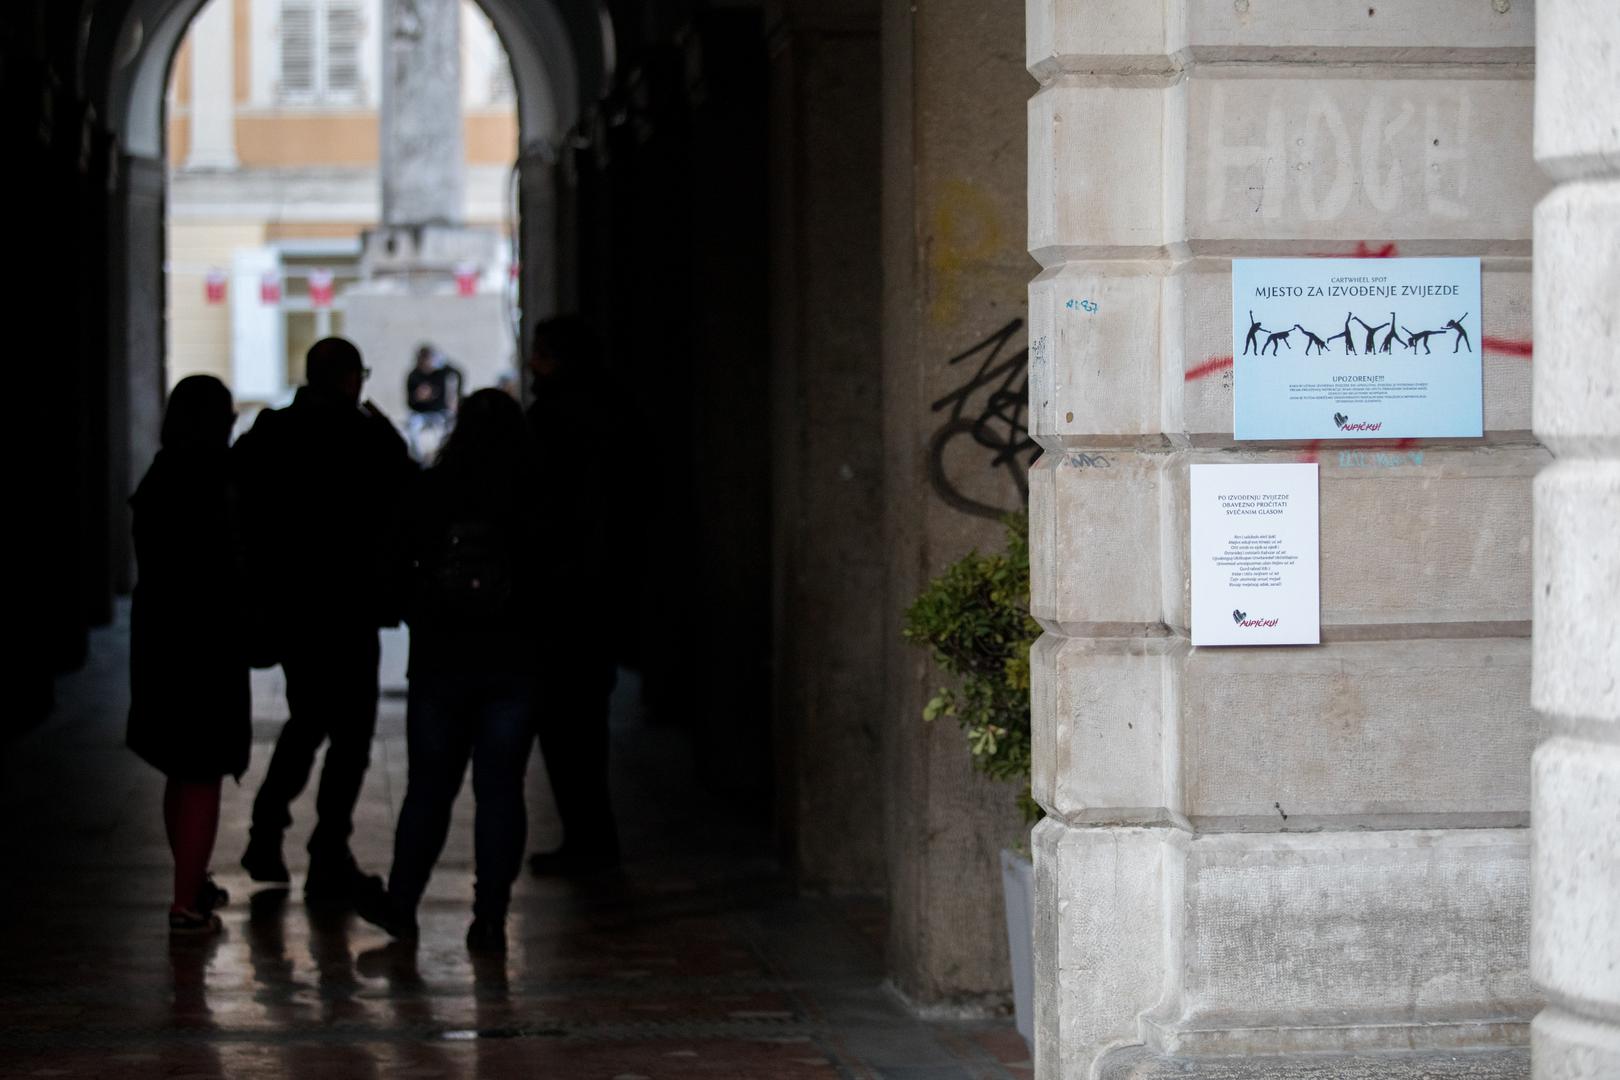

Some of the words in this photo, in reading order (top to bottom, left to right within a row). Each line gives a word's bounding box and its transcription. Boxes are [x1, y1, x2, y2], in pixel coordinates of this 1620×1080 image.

[1255, 286, 1303, 299] MJESTO
[1307, 286, 1324, 297] ZA
[1328, 285, 1397, 298] IZVOĐENJE
[1401, 285, 1459, 298] ZVIJEZDE
